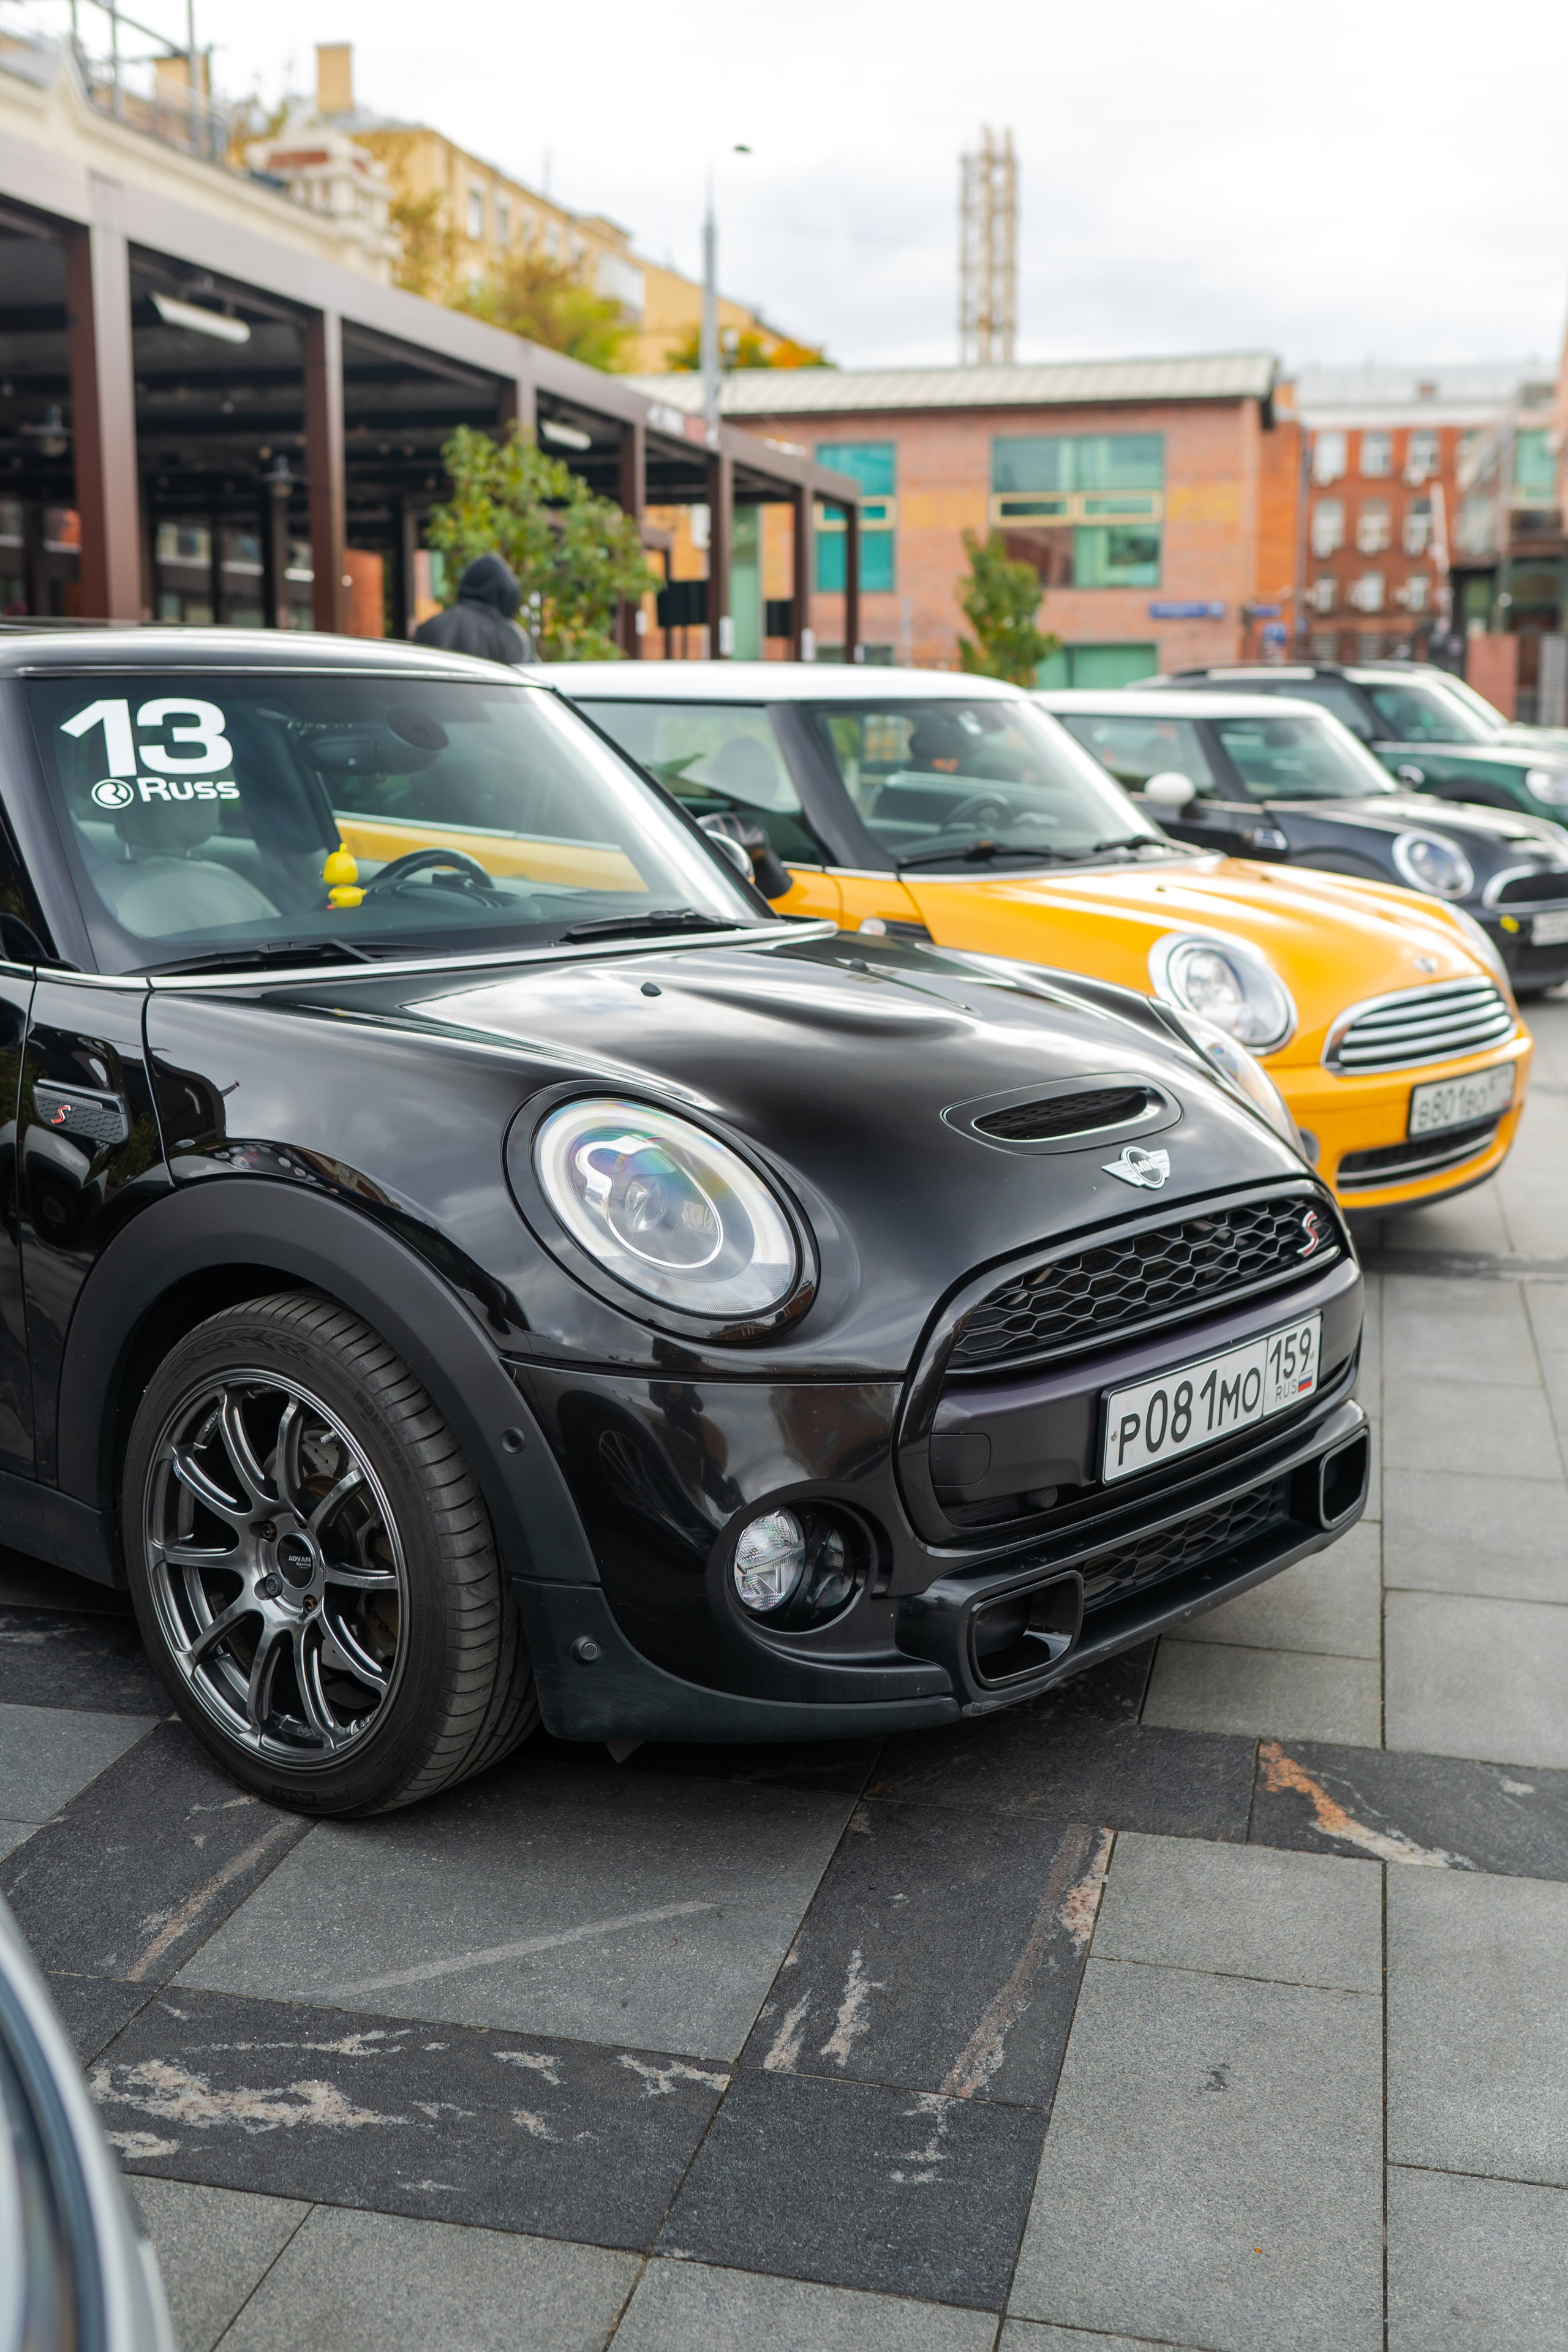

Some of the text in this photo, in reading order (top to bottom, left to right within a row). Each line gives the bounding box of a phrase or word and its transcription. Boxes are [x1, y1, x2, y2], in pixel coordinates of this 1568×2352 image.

[60, 698, 233, 777] 13
[137, 776, 240, 802] Russ
[51, 1105, 71, 1124] S
[1133, 1158, 1158, 1174] MINI
[1297, 1210, 1319, 1257] S
[1270, 1327, 1312, 1384] 159
[1275, 1379, 1297, 1403] RUS
